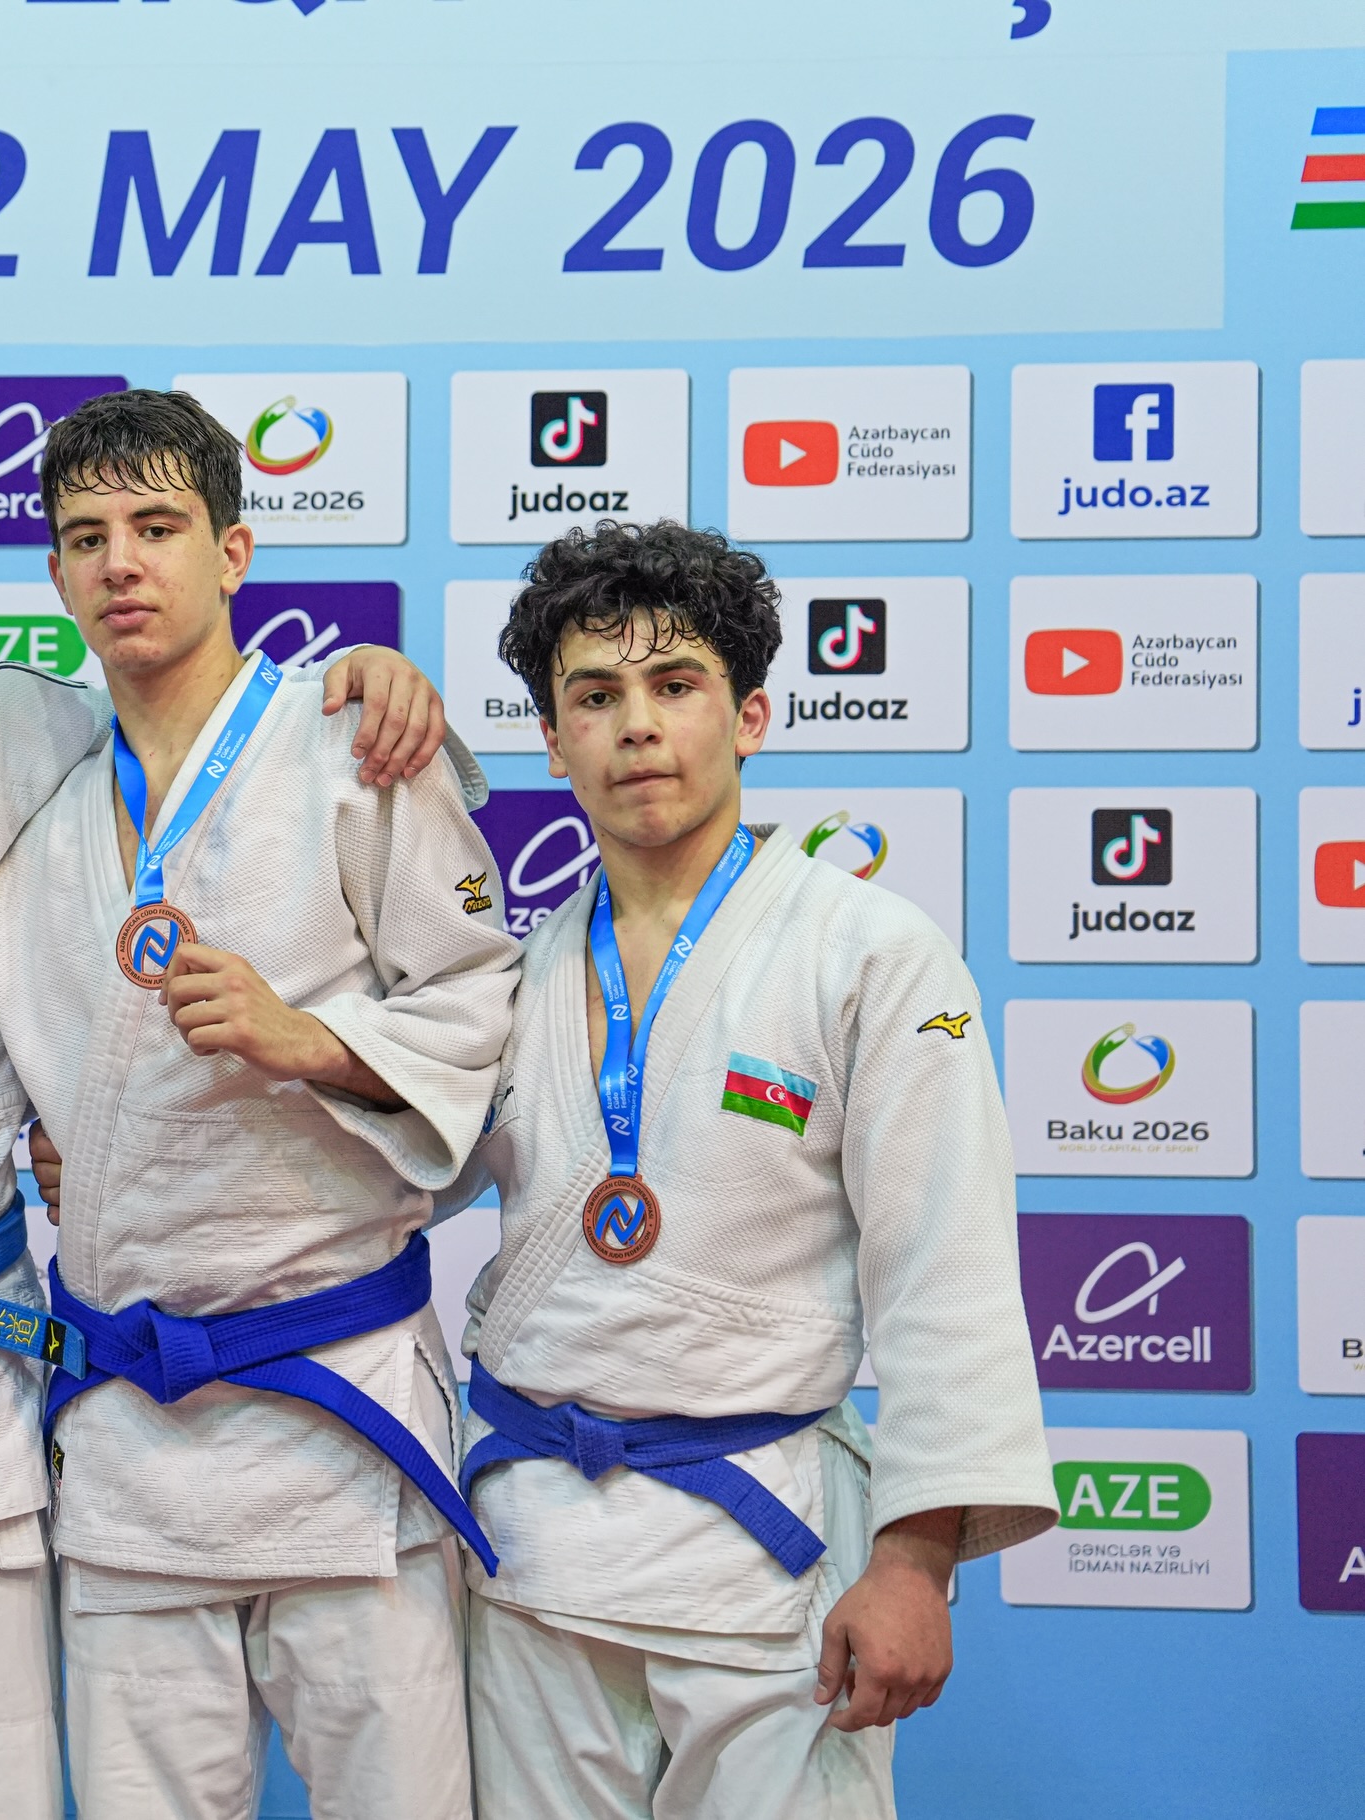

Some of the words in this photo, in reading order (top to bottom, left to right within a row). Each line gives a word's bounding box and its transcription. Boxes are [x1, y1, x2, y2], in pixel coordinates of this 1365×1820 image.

[88, 126, 518, 277] MAY
[562, 114, 1035, 272] 2026
[849, 426, 950, 445] Azərbaycan
[848, 444, 893, 458] Cüdo
[848, 462, 955, 479] Federasiyası
[293, 492, 364, 510] 2026
[509, 484, 628, 523] judoaz
[1058, 478, 1209, 515] judo.az
[1133, 635, 1236, 654] Azərbaycan
[1132, 653, 1178, 667] Cüdo
[1132, 671, 1242, 689] Federasiyası
[786, 692, 908, 728] judoaz
[1069, 902, 1195, 939] judoaz
[1048, 1120, 1123, 1140] Baku
[1133, 1122, 1209, 1141] 2026
[1042, 1325, 1211, 1362] Azercell
[1067, 1474, 1180, 1519] AZE
[1068, 1543, 1150, 1558] GƏNCLƏR
[1158, 1544, 1180, 1558] VƏ
[1068, 1557, 1125, 1573] İDMAN
